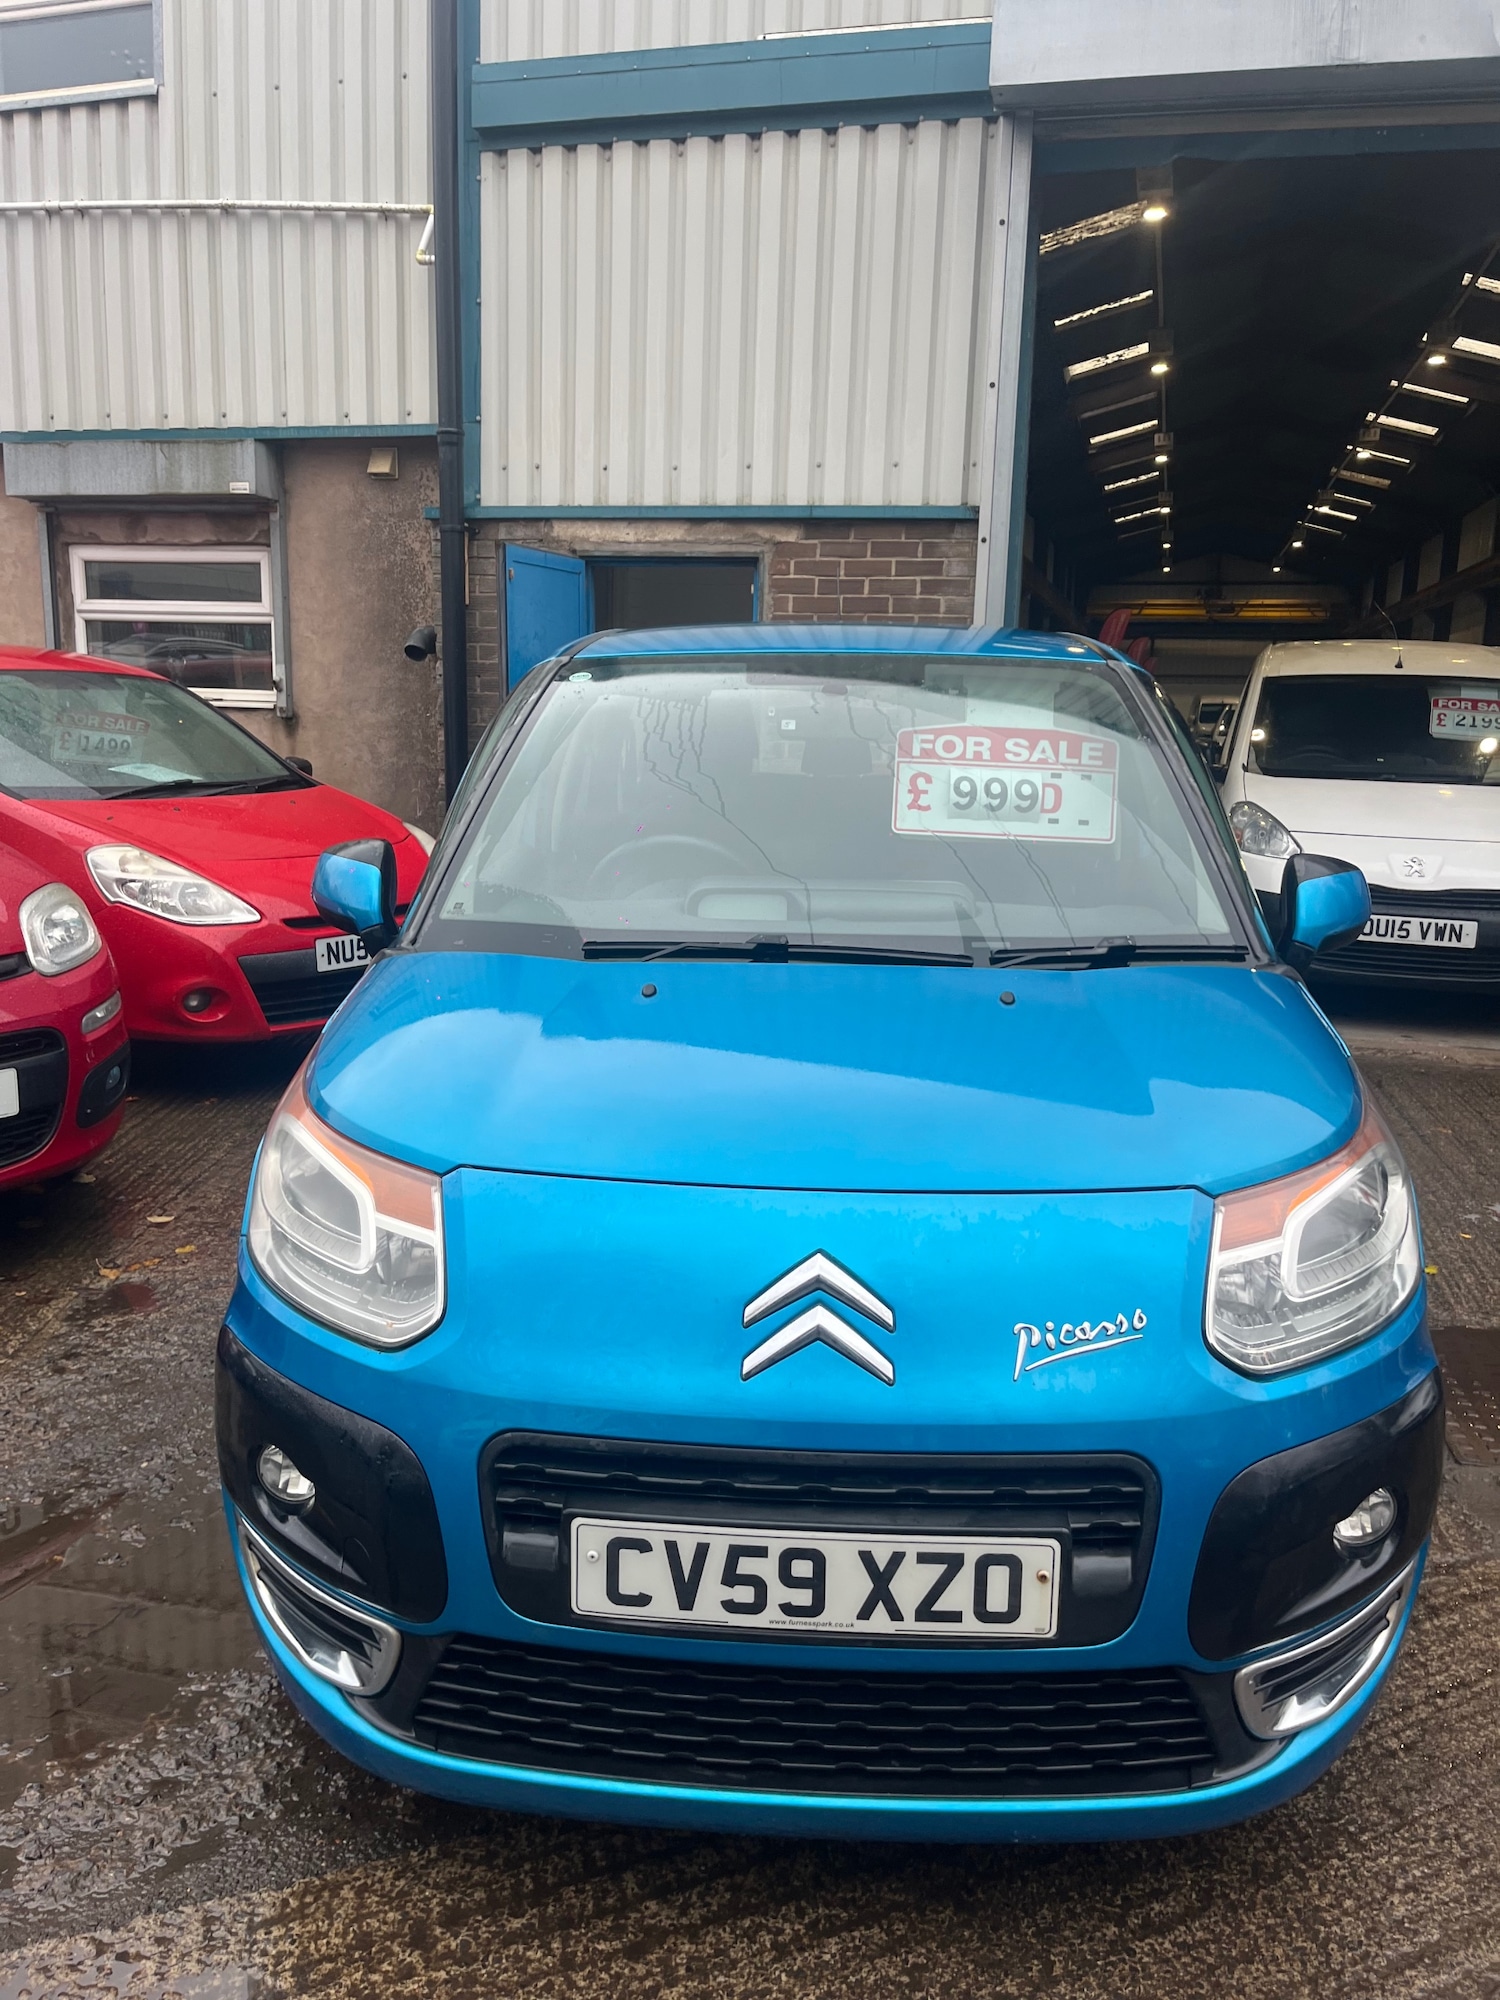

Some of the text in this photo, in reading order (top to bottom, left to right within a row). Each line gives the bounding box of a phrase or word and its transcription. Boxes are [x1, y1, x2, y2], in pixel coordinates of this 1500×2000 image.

[1438, 699, 1472, 710] FOR
[63, 712, 145, 733] FOR SALE
[1436, 712, 1447, 727] £
[81, 735, 131, 755] 1499
[911, 733, 1104, 766] FOR SALE
[906, 771, 934, 812] £
[1419, 921, 1464, 943] VWN
[605, 1536, 1024, 1625] CV59 XZO
[768, 1618, 856, 1629] www.furnesspark.co.uk
